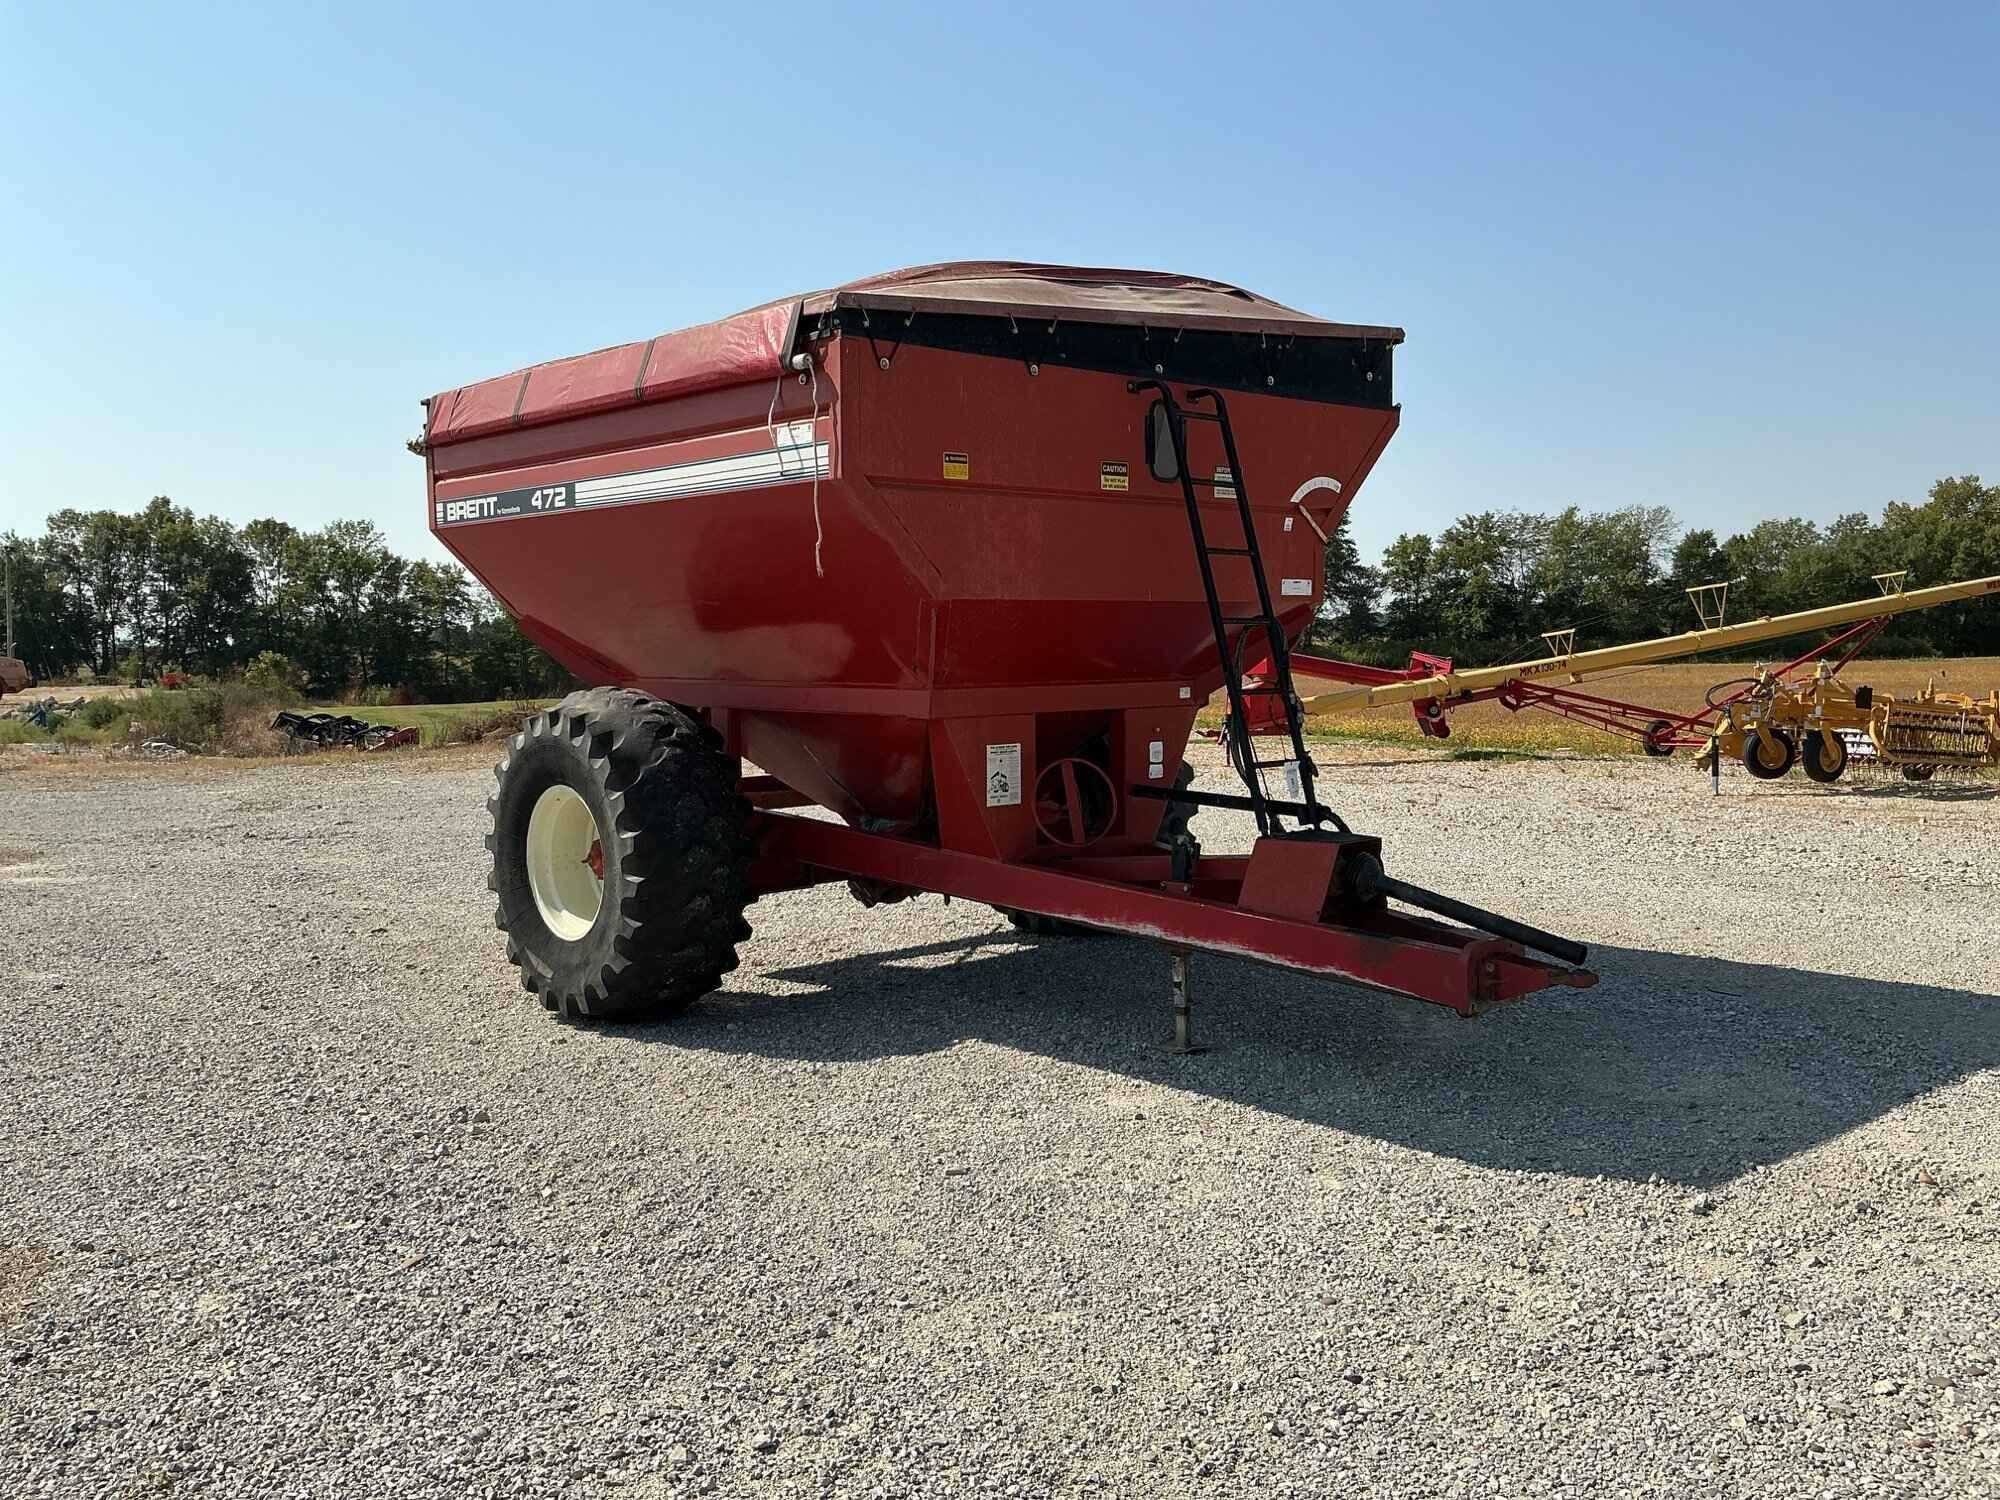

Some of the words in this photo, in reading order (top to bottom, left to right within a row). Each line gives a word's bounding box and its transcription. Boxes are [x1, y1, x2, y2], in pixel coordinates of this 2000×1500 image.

[1103, 464, 1127, 473] CAUTION
[446, 496, 498, 521] BRENT
[531, 486, 566, 510] 472
